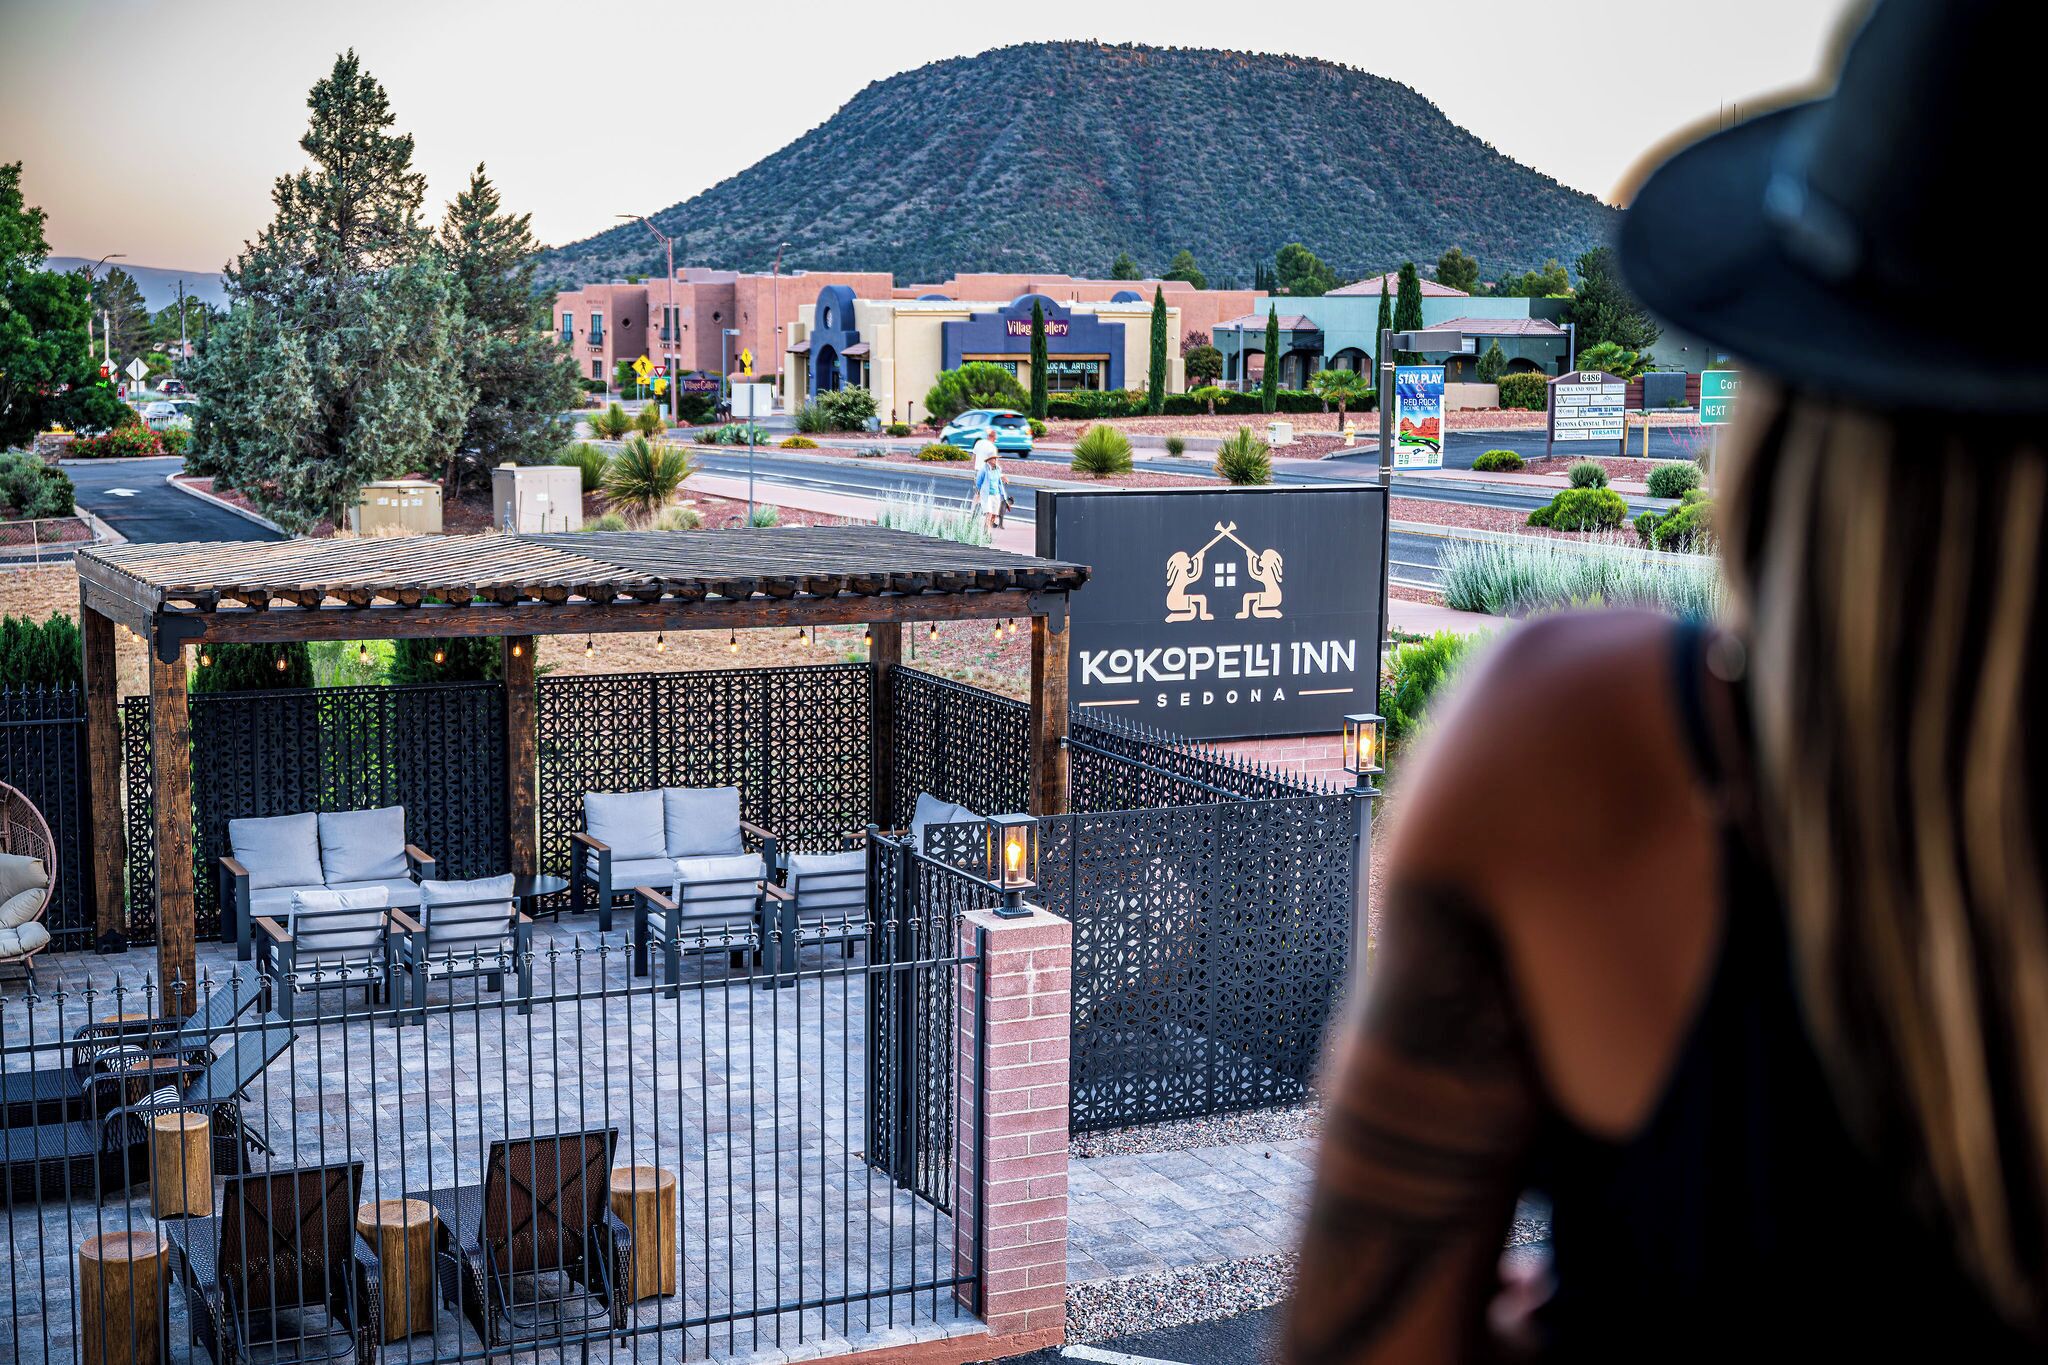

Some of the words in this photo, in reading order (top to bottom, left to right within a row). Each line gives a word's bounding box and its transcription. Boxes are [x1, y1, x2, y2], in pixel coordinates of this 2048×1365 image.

[1007, 320, 1032, 335] Villag
[1044, 320, 1068, 335] allery
[1046, 362, 1067, 370] LOCAL
[1071, 362, 1098, 370] ARTISTS
[1398, 373, 1419, 384] STAY
[1420, 373, 1442, 384] PLAY
[1581, 373, 1600, 382] 6486
[1403, 398, 1417, 406] RED
[1418, 398, 1437, 406] ROCK
[1705, 405, 1726, 416] NEXT
[1079, 643, 1280, 685] KOKOPELLI
[1290, 639, 1356, 675] INN
[1156, 687, 1286, 708] SEDONA
